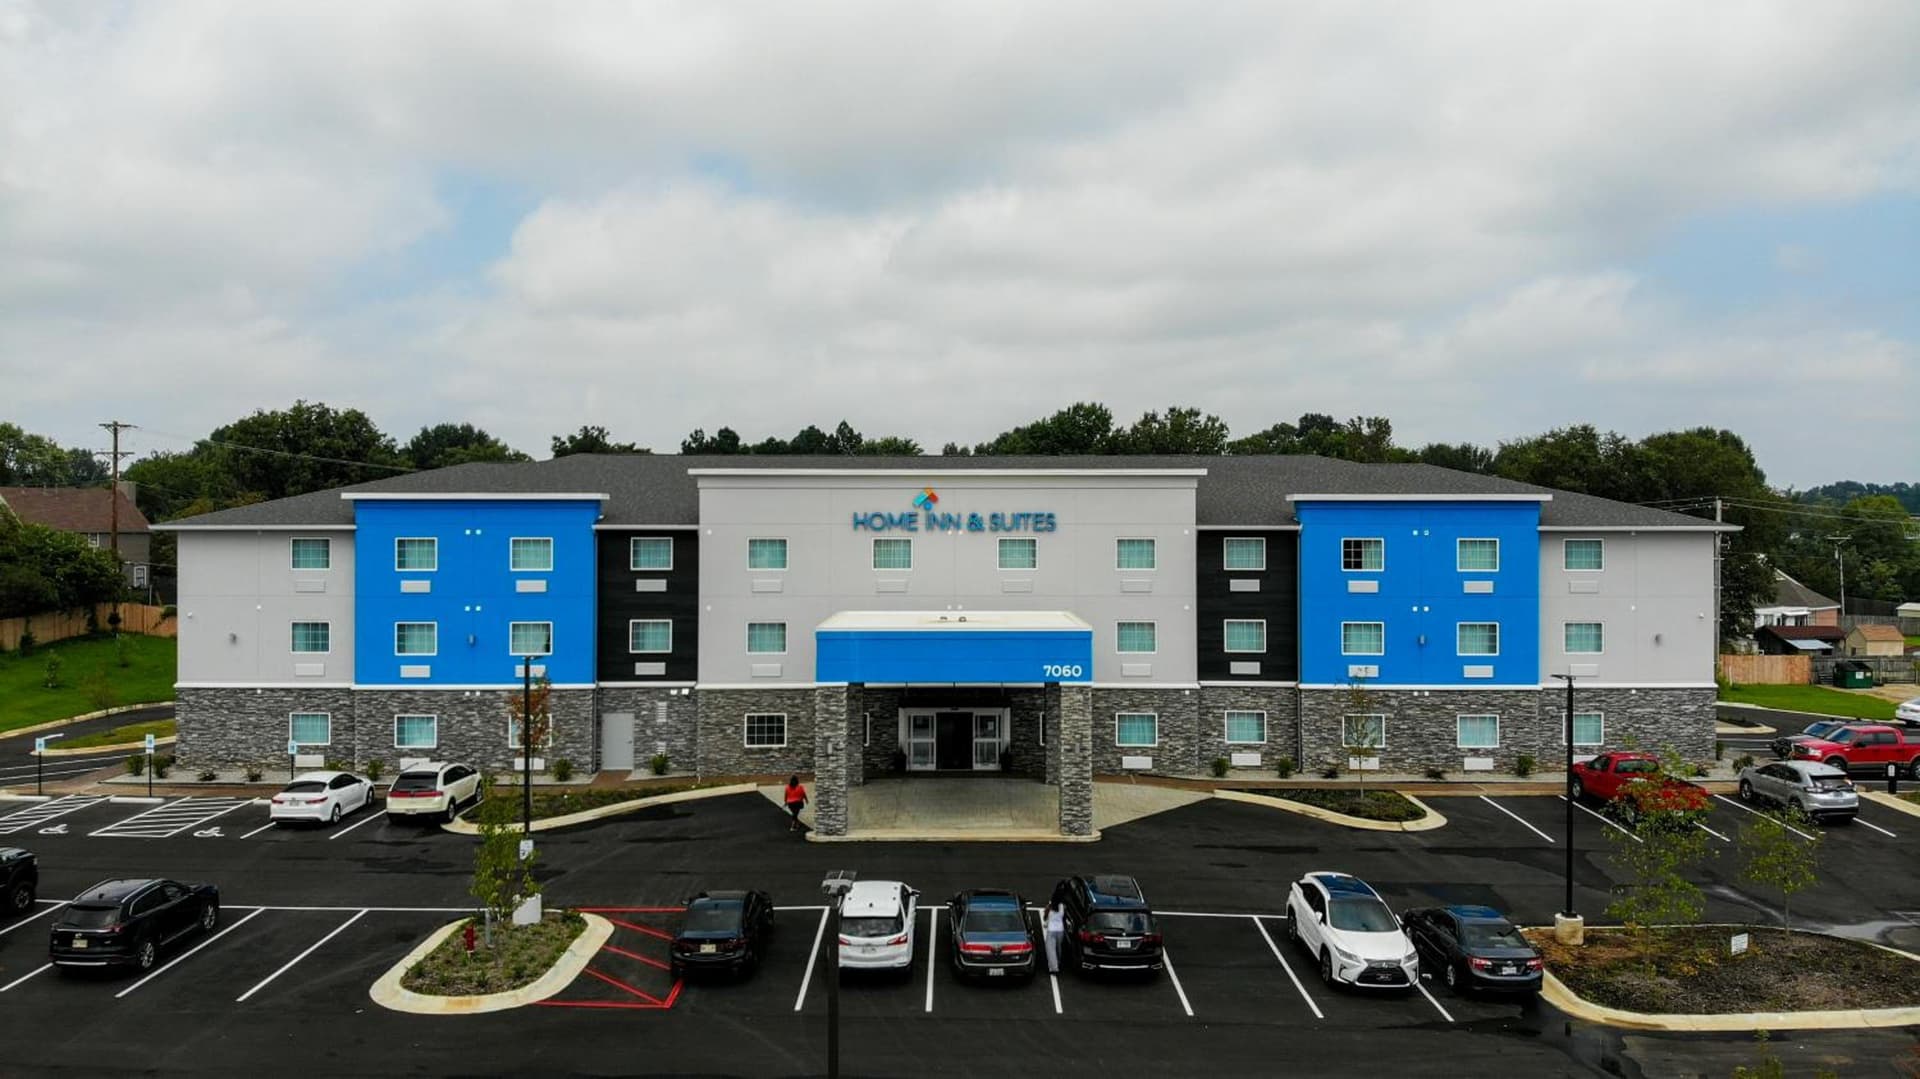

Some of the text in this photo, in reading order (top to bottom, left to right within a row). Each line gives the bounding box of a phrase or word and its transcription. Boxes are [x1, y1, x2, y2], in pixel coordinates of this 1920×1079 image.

[853, 512, 1057, 532] HOME INN & SUITES
[1043, 665, 1082, 677] 7060
